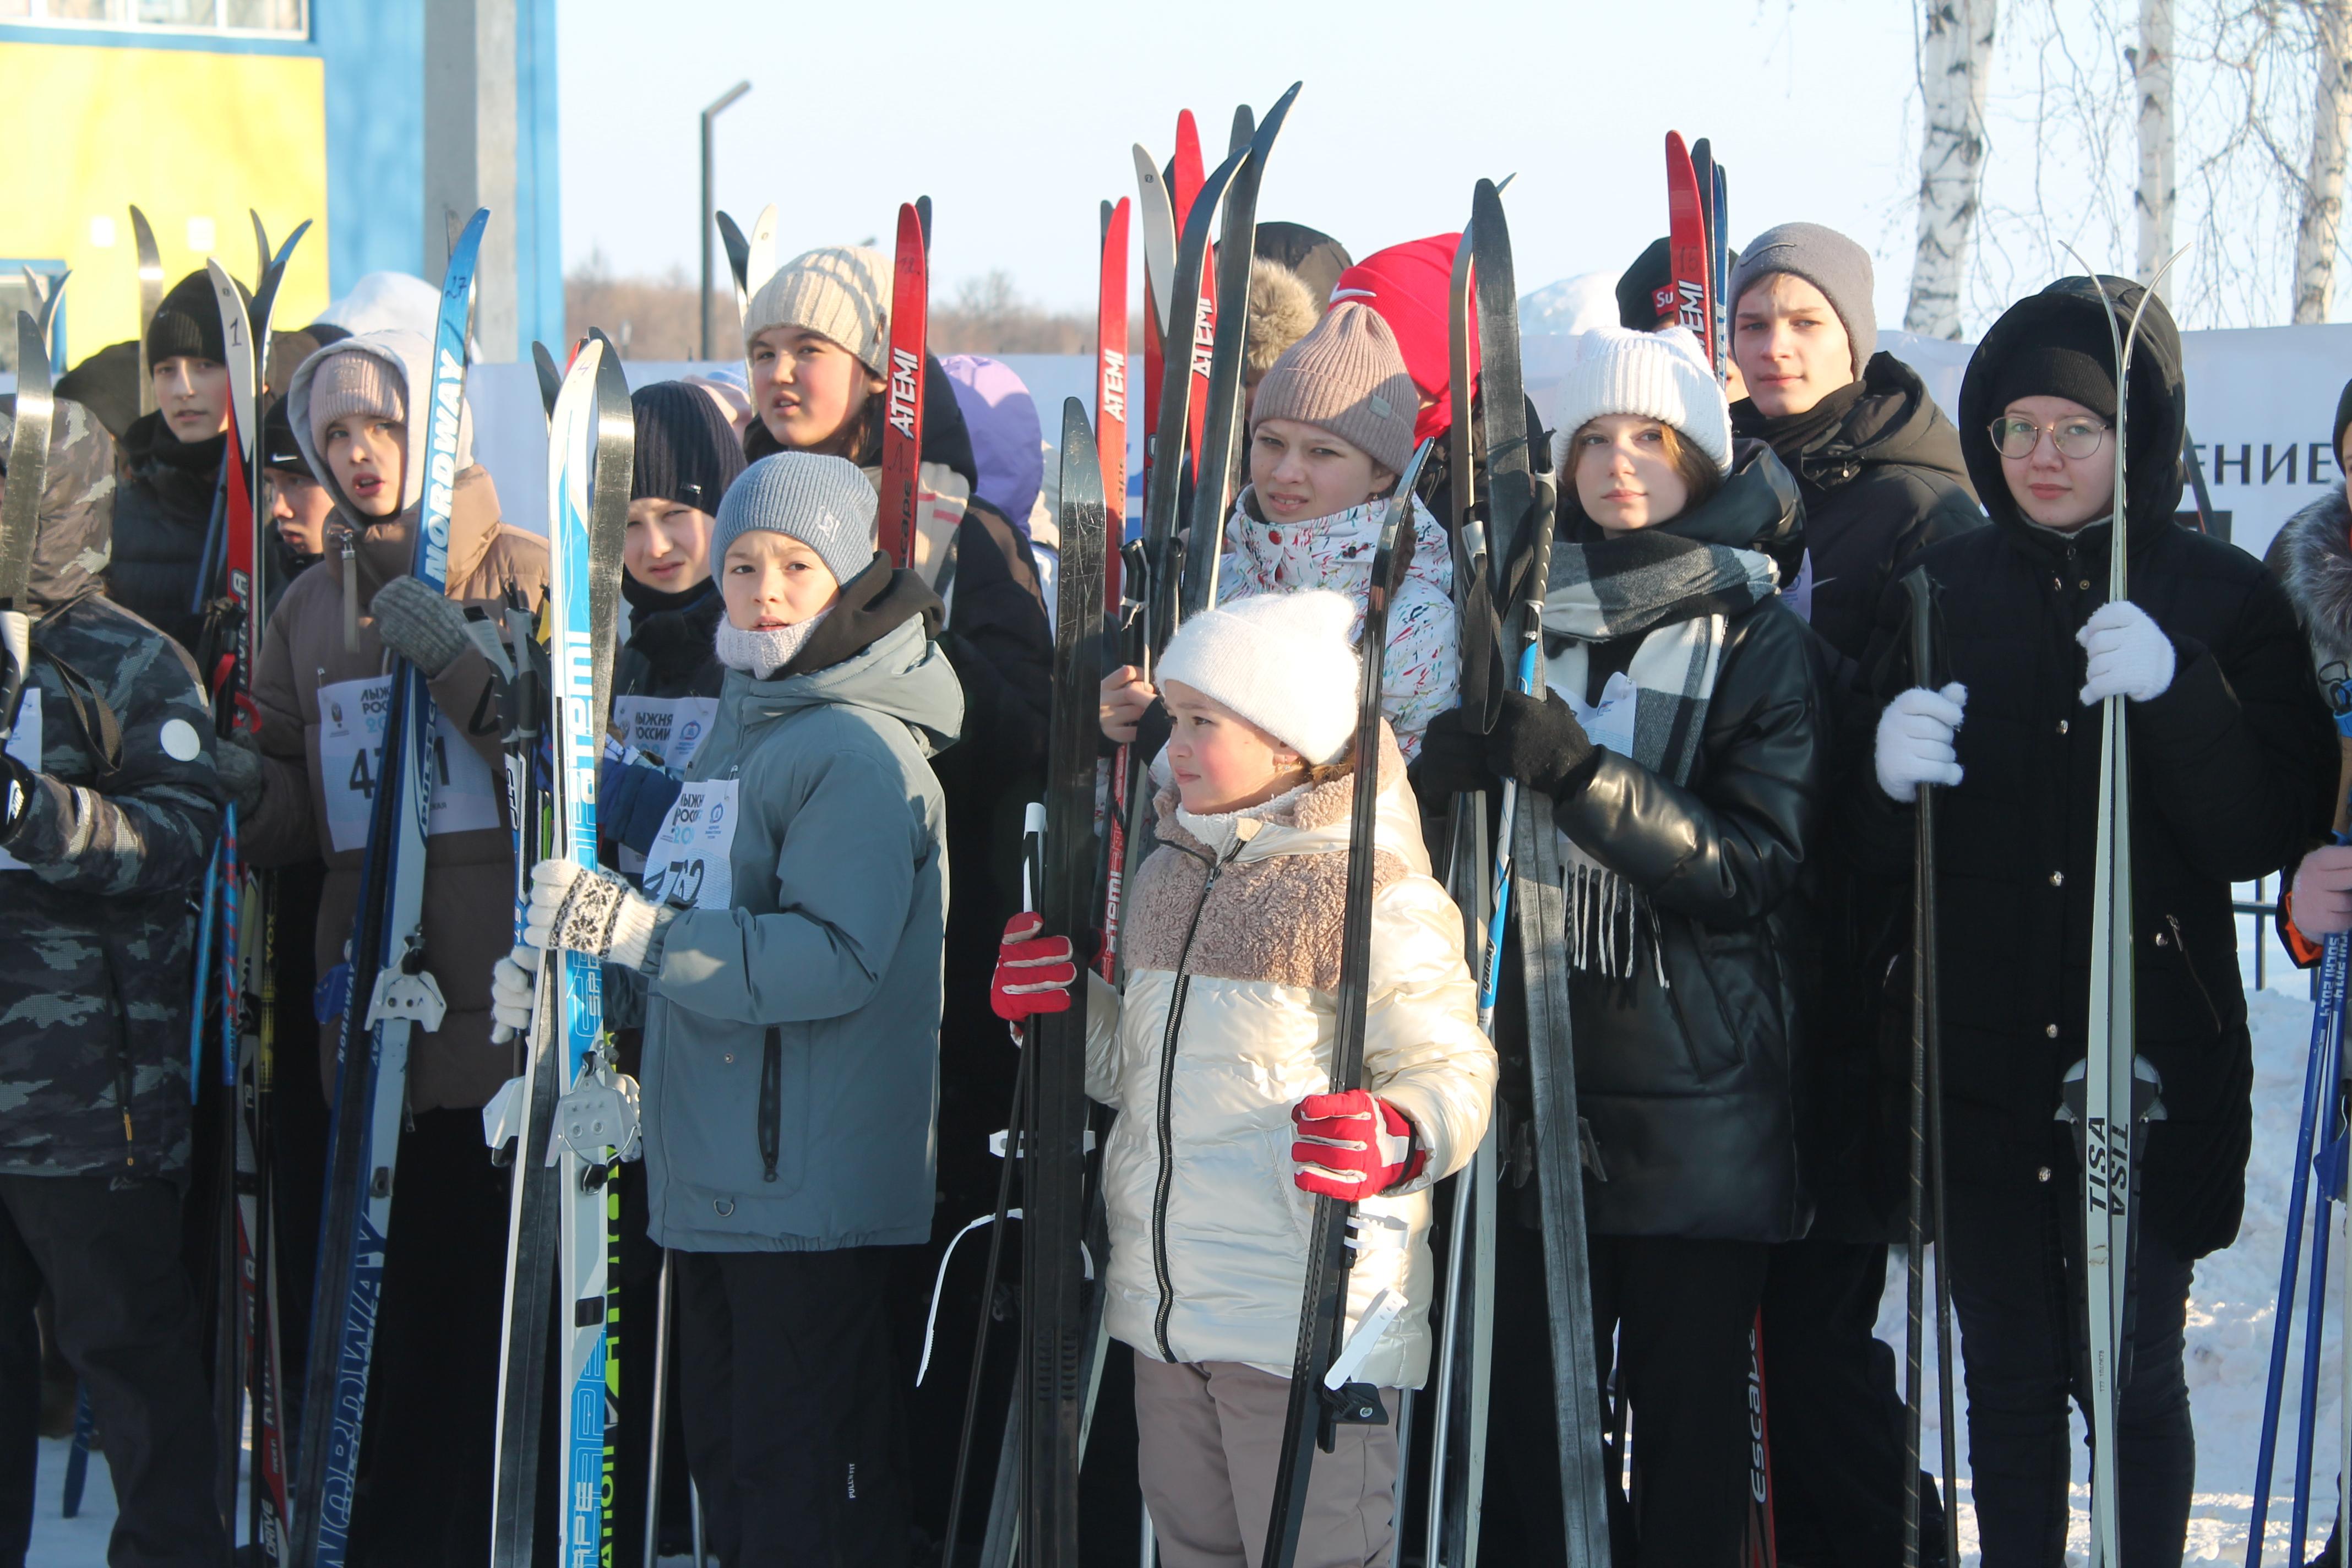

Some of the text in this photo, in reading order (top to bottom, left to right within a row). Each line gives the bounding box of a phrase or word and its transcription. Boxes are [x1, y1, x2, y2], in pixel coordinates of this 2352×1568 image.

[1193, 297, 1215, 380] ATEMI
[1678, 279, 1705, 337] EMI
[890, 348, 919, 440] ATEMI
[1104, 349, 1125, 423] ATEMI
[424, 348, 463, 584] NORDWAY
[361, 686, 391, 702] ЛЫЖ
[366, 715, 386, 733] 20
[420, 723, 435, 826] PULSE
[1483, 938, 1495, 993] galaxy
[2320, 937, 2340, 1017] SOCHI 2014
[337, 962, 355, 1064] NORDWAY
[2088, 1118, 2106, 1212] TISA
[2112, 1123, 2128, 1216] TISA
[262, 1498, 277, 1559] DRIVE
